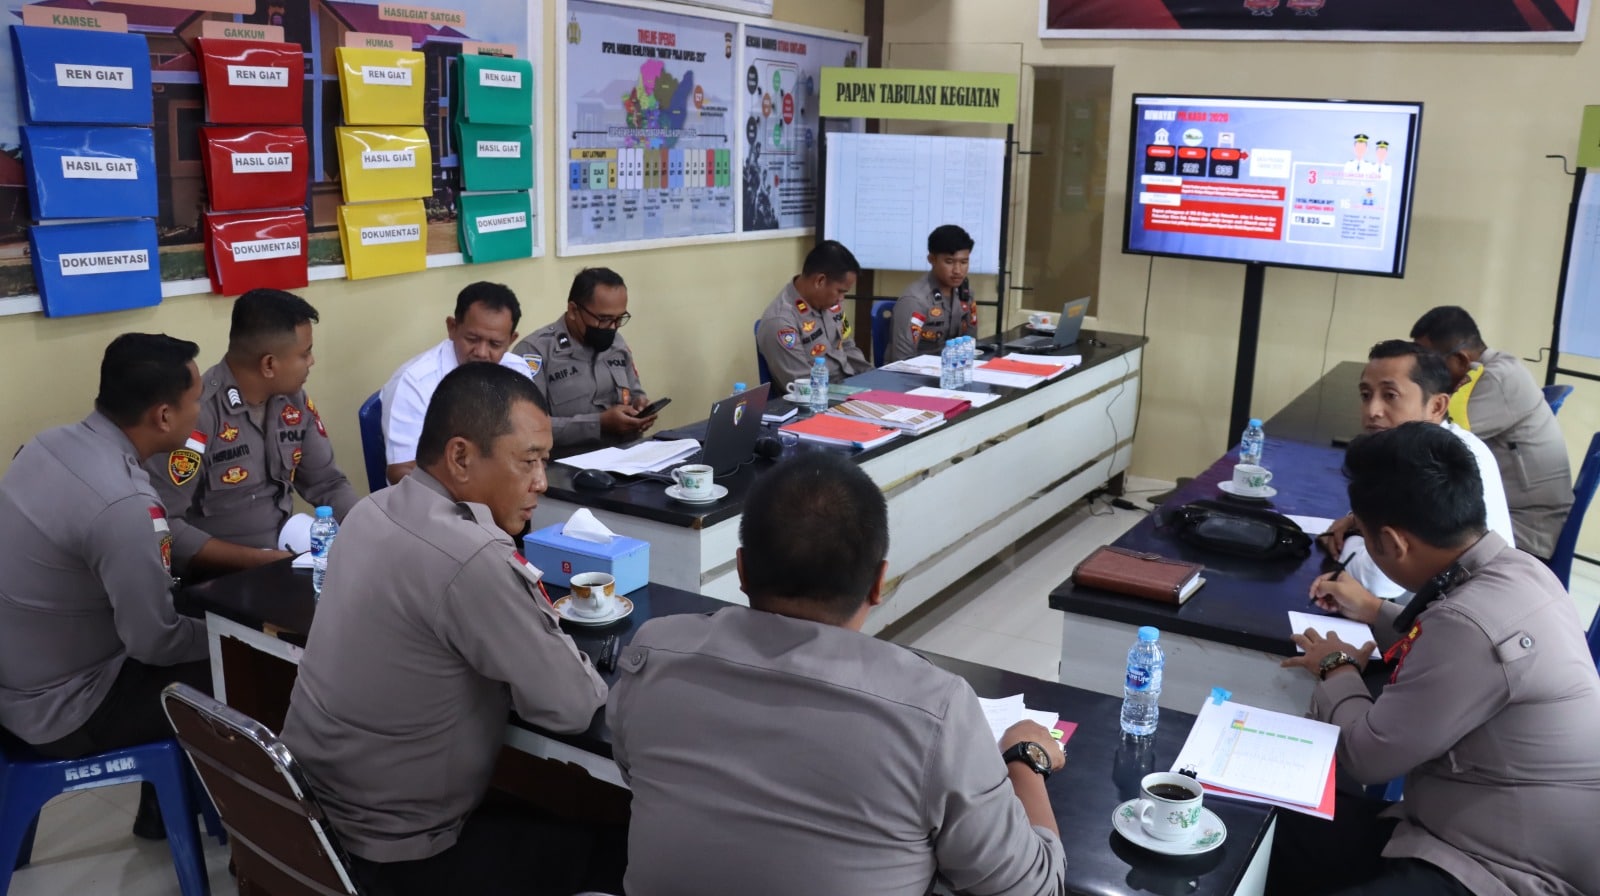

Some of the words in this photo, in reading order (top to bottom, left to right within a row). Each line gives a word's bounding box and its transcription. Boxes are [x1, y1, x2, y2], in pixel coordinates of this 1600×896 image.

[52, 14, 102, 28] KAMSEL
[384, 7, 429, 20] HASILGIAT
[430, 11, 461, 23] SATGAS
[224, 28, 265, 40] GAKKUM
[366, 38, 394, 48] HUMAS
[66, 69, 92, 80] REN
[96, 70, 124, 81] GIAT
[236, 70, 256, 79] REN
[259, 71, 282, 80] GIAT
[369, 70, 386, 79] REN
[387, 71, 406, 80] GIAT
[485, 73, 499, 81] REN
[501, 74, 516, 83] GIAT
[836, 82, 876, 103] PAPAN
[880, 83, 937, 105] TABULASI
[940, 85, 1000, 108] KEGIATAN
[479, 144, 500, 153] HASIL
[502, 145, 519, 153] GIAT
[235, 157, 265, 166] HASIL
[267, 156, 290, 166] GIAT
[364, 154, 391, 163] HASIL
[392, 153, 413, 162] GIAT
[66, 161, 103, 172] HASIL
[106, 162, 133, 172] GIAT
[1308, 170, 1317, 184] 3
[478, 215, 525, 228] DOKUMENTASI
[362, 228, 419, 240] DOKUMENTASI
[234, 241, 300, 255] DOKUMENTASI
[62, 254, 147, 268] DOKUMENTASI
[64, 763, 102, 781] RES
